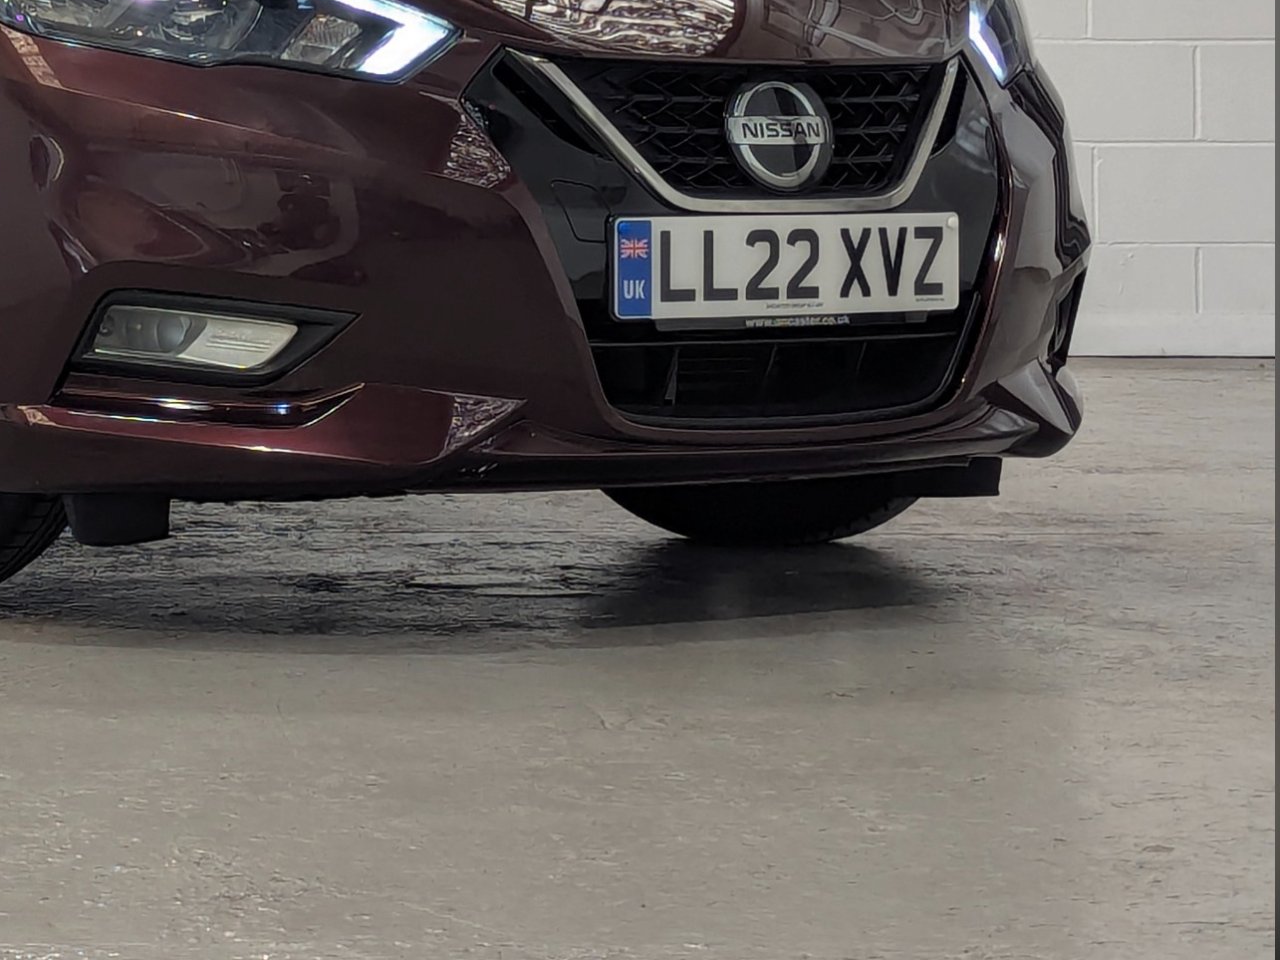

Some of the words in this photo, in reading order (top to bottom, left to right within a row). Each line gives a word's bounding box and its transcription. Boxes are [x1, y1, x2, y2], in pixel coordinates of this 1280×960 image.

[741, 122, 820, 139] NISSAN
[660, 228, 820, 303] LL22
[839, 225, 944, 298] XVZ
[623, 279, 646, 300] UK
